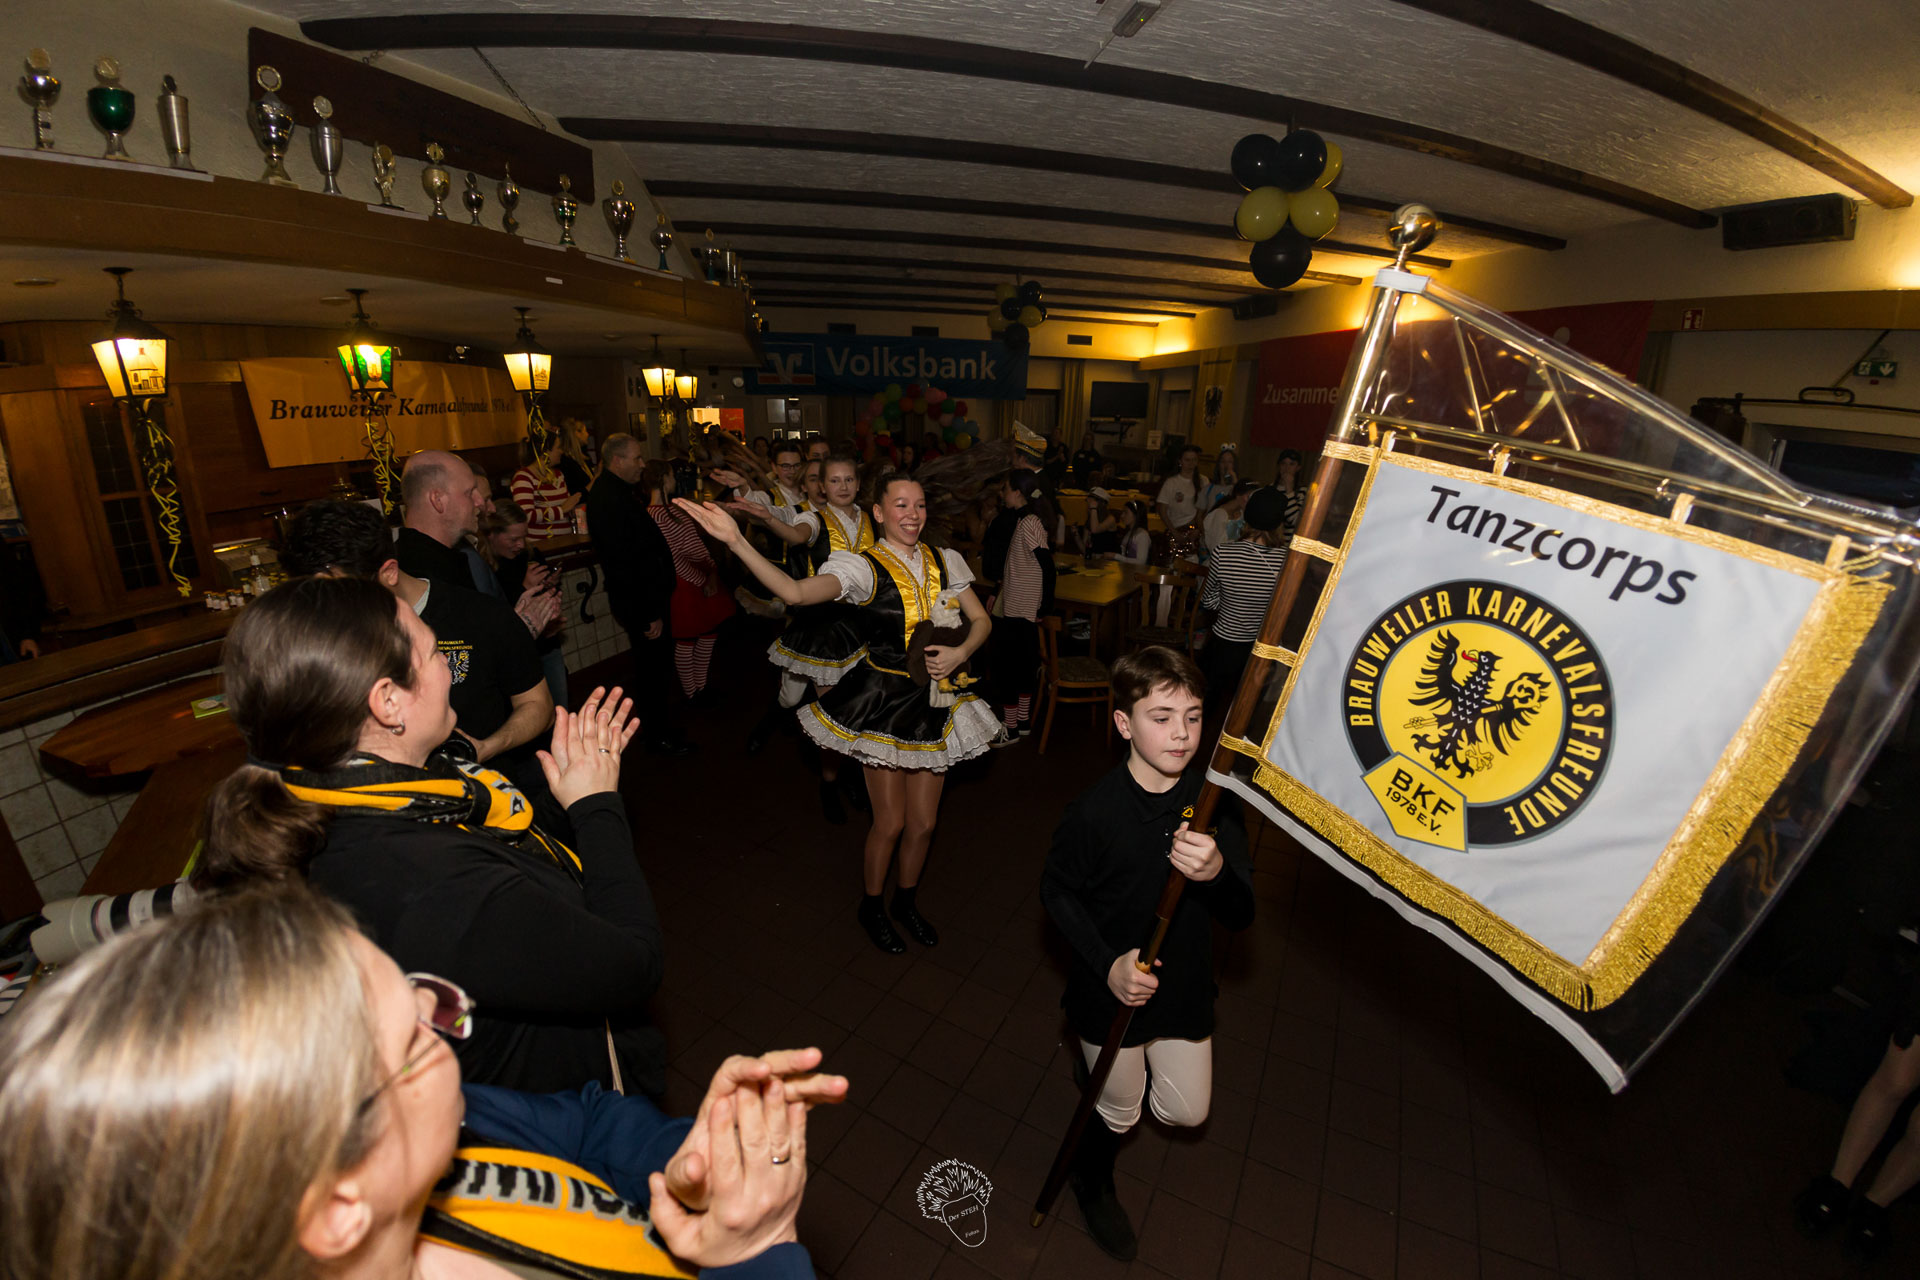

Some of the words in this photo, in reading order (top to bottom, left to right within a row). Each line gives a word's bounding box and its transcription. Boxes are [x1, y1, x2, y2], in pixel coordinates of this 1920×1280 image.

[826, 346, 997, 381] Volksbank
[1262, 383, 1340, 405] Zusamme
[1426, 485, 1697, 605] Tanzcorps
[1348, 590, 1453, 727] BRAUWEILER
[1466, 587, 1606, 836] KARNEVALSFREUNDE
[1385, 787, 1418, 816] 1978
[1391, 768, 1456, 817] BKF
